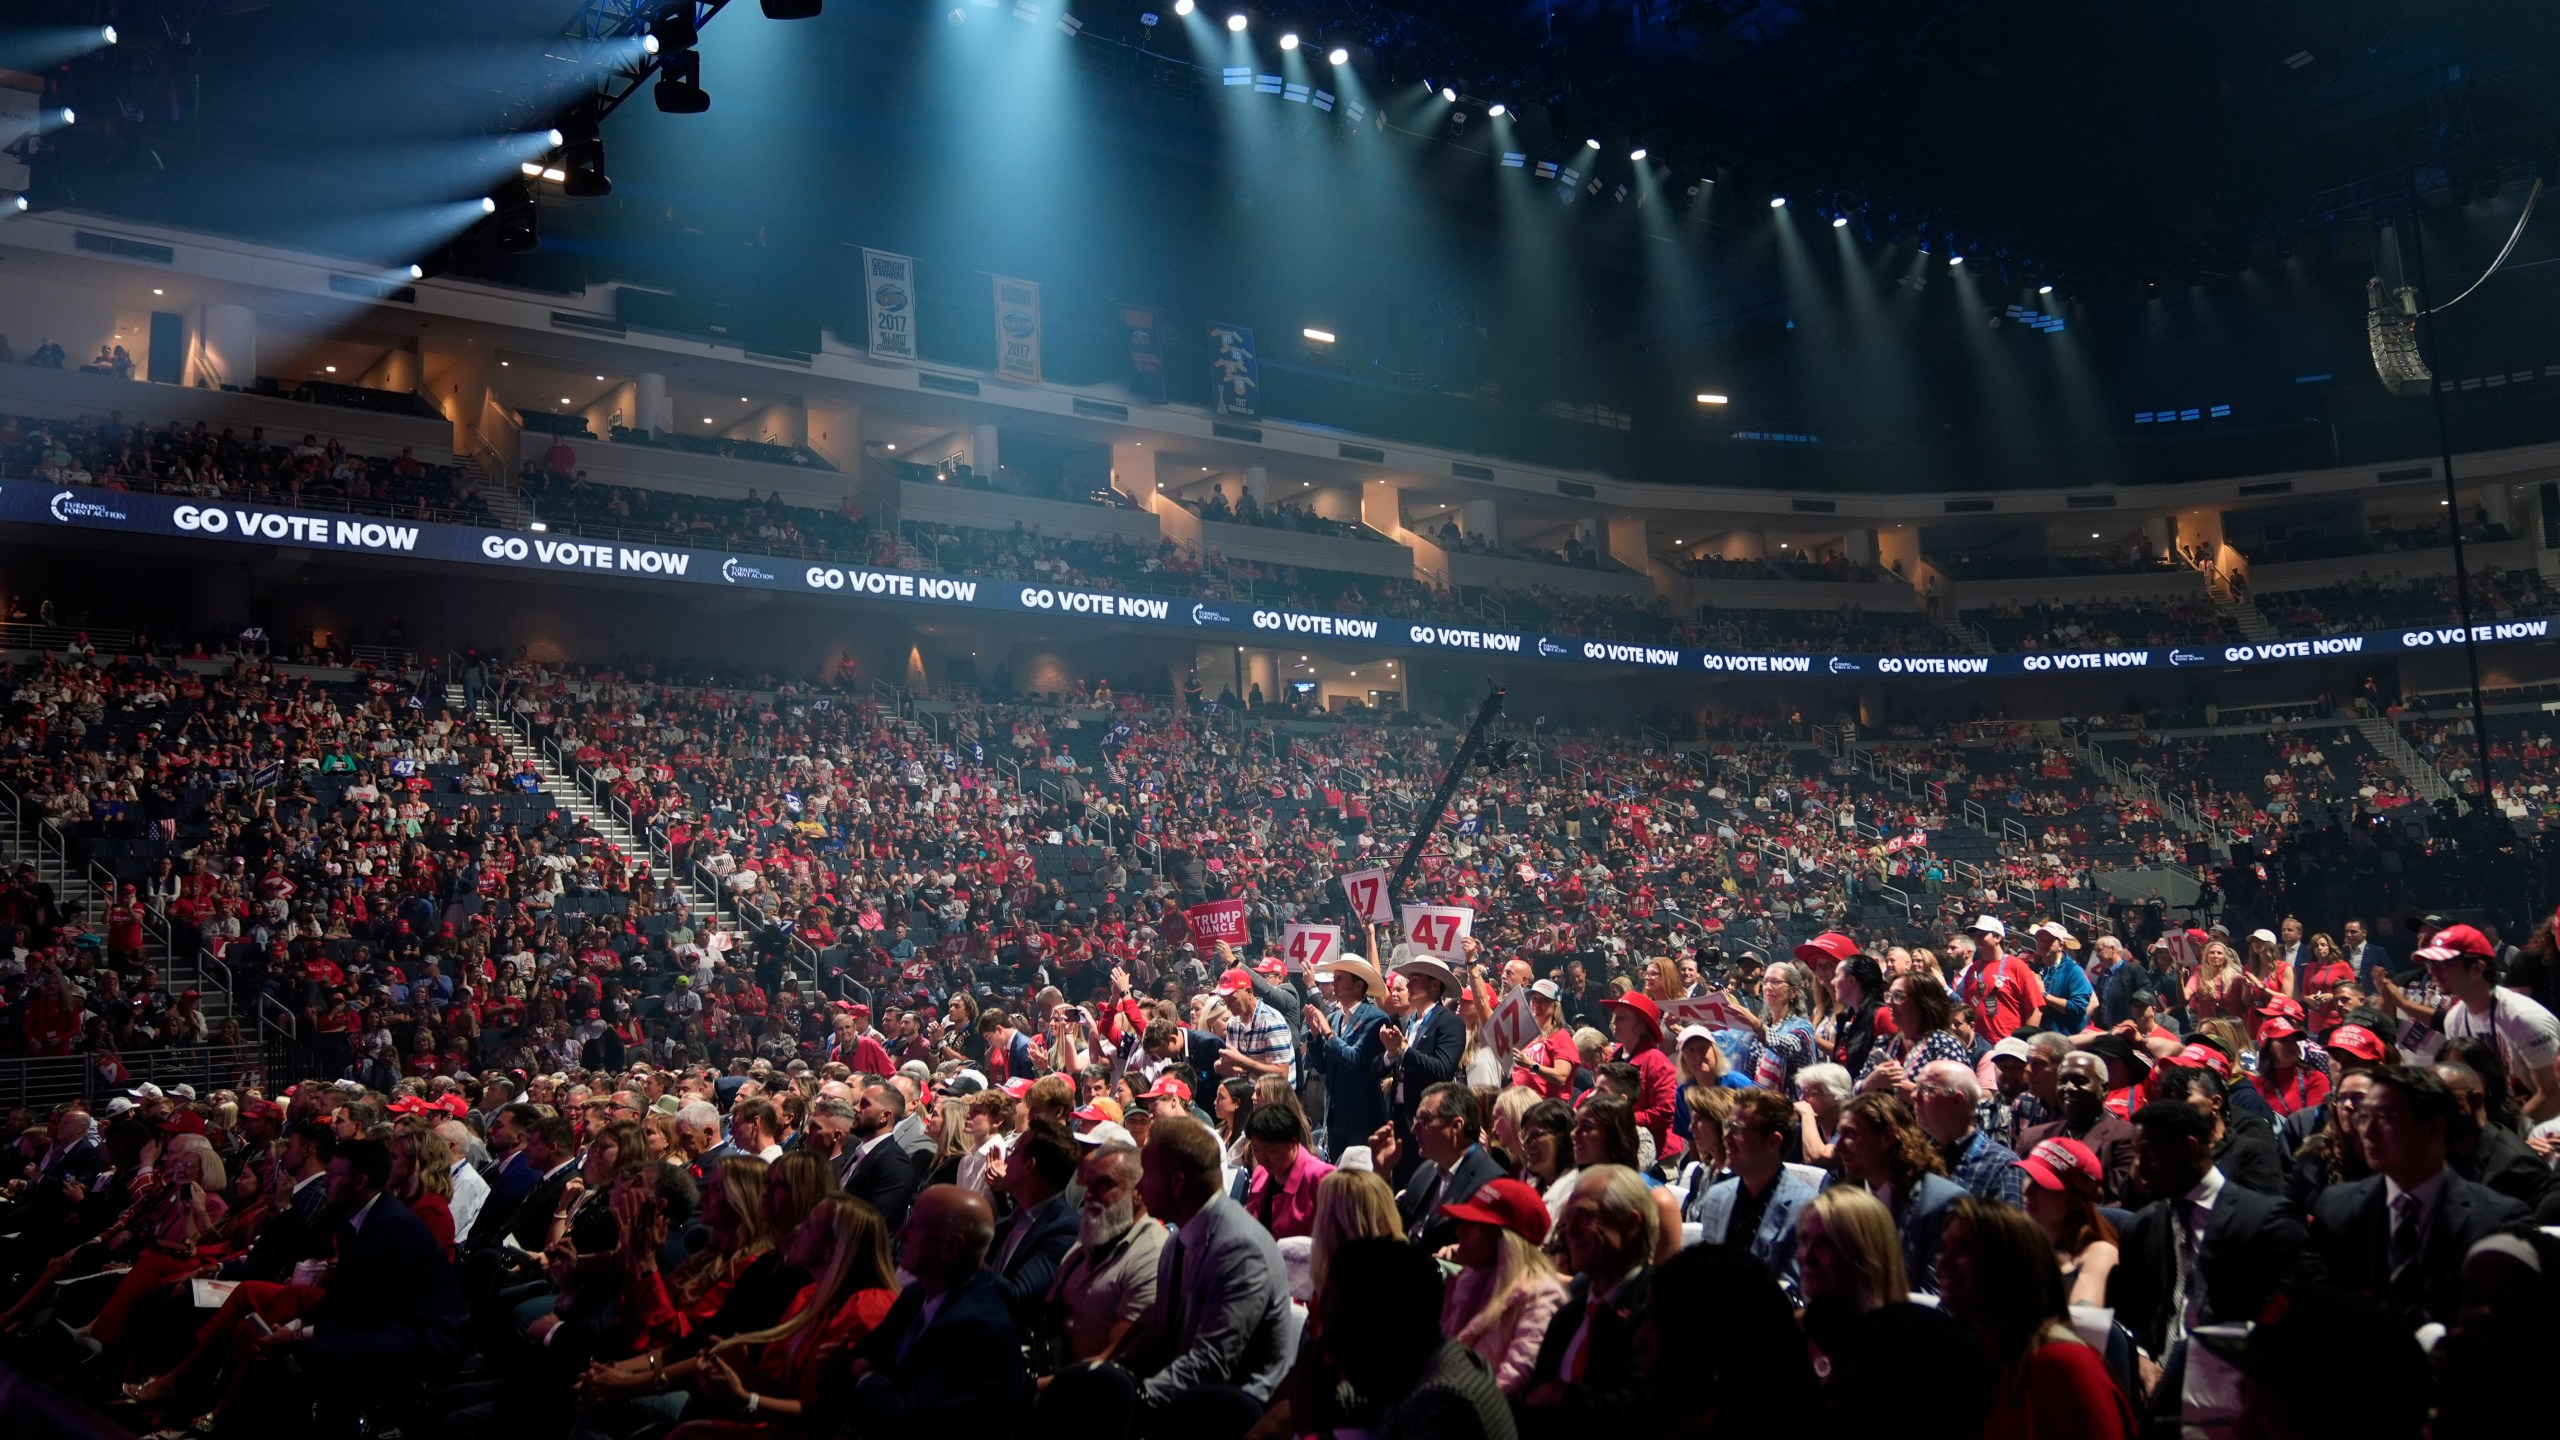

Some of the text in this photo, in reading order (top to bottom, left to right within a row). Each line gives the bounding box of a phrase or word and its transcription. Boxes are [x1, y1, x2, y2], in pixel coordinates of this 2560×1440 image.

[872, 258, 904, 271] GEORGIA
[872, 268, 904, 280] SWARM
[878, 312, 907, 332] 2017
[892, 333, 907, 341] EAST
[1007, 342, 1030, 359] 2017
[64, 502, 105, 512] TURNING
[64, 507, 126, 520] POINT ACTION
[174, 506, 418, 550] GO VOTE NOW
[482, 536, 689, 576] GO VOTE NOW
[731, 566, 760, 574] TURNING
[731, 570, 774, 580] POINT ACTION
[806, 567, 976, 601] GO VOTE NOW
[1021, 588, 1168, 619] GO VOTE NOW
[1253, 611, 1377, 638] GO VOTE NOW
[243, 627, 263, 638] 47
[1410, 626, 1520, 651] GO VOTE NOW
[2403, 620, 2547, 647] GO VOTE NOW
[1584, 643, 1678, 666] GO VOTE NOW
[2225, 637, 2362, 662] GO VOTE NOW
[1704, 655, 1810, 671] GO VOTE NOW
[1879, 658, 1988, 673] GO VOTE NOW
[2024, 651, 2147, 671] GO VOTE NOW
[371, 680, 391, 692] 47
[813, 700, 829, 711] 47
[1114, 725, 1130, 736] 47
[1102, 732, 1115, 746] 47
[975, 747, 984, 760] 47
[1643, 749, 1653, 757] 47
[394, 761, 416, 774] 47
[944, 753, 957, 769] 47
[1318, 763, 1331, 776] 47
[1460, 821, 1476, 834] 47
[1692, 836, 1707, 847] 47
[1889, 837, 1902, 848] 47
[1909, 834, 1924, 844] 47
[1013, 857, 1033, 870] 47
[1738, 854, 1755, 866] 47
[1441, 867, 1460, 879] 47
[1769, 876, 1783, 886] 47
[1012, 888, 1029, 903] 47
[1350, 878, 1379, 918] 47
[1194, 910, 1242, 926] TRUMP
[1199, 922, 1236, 935] VANCE
[1411, 915, 1461, 952] 47
[1577, 920, 1592, 934] 47
[946, 936, 968, 951] 47
[1289, 932, 1331, 964] 47
[1526, 935, 1542, 948] 47
[2167, 936, 2185, 961] 47
[906, 962, 928, 976] 47
[1494, 999, 1519, 1055] 47
